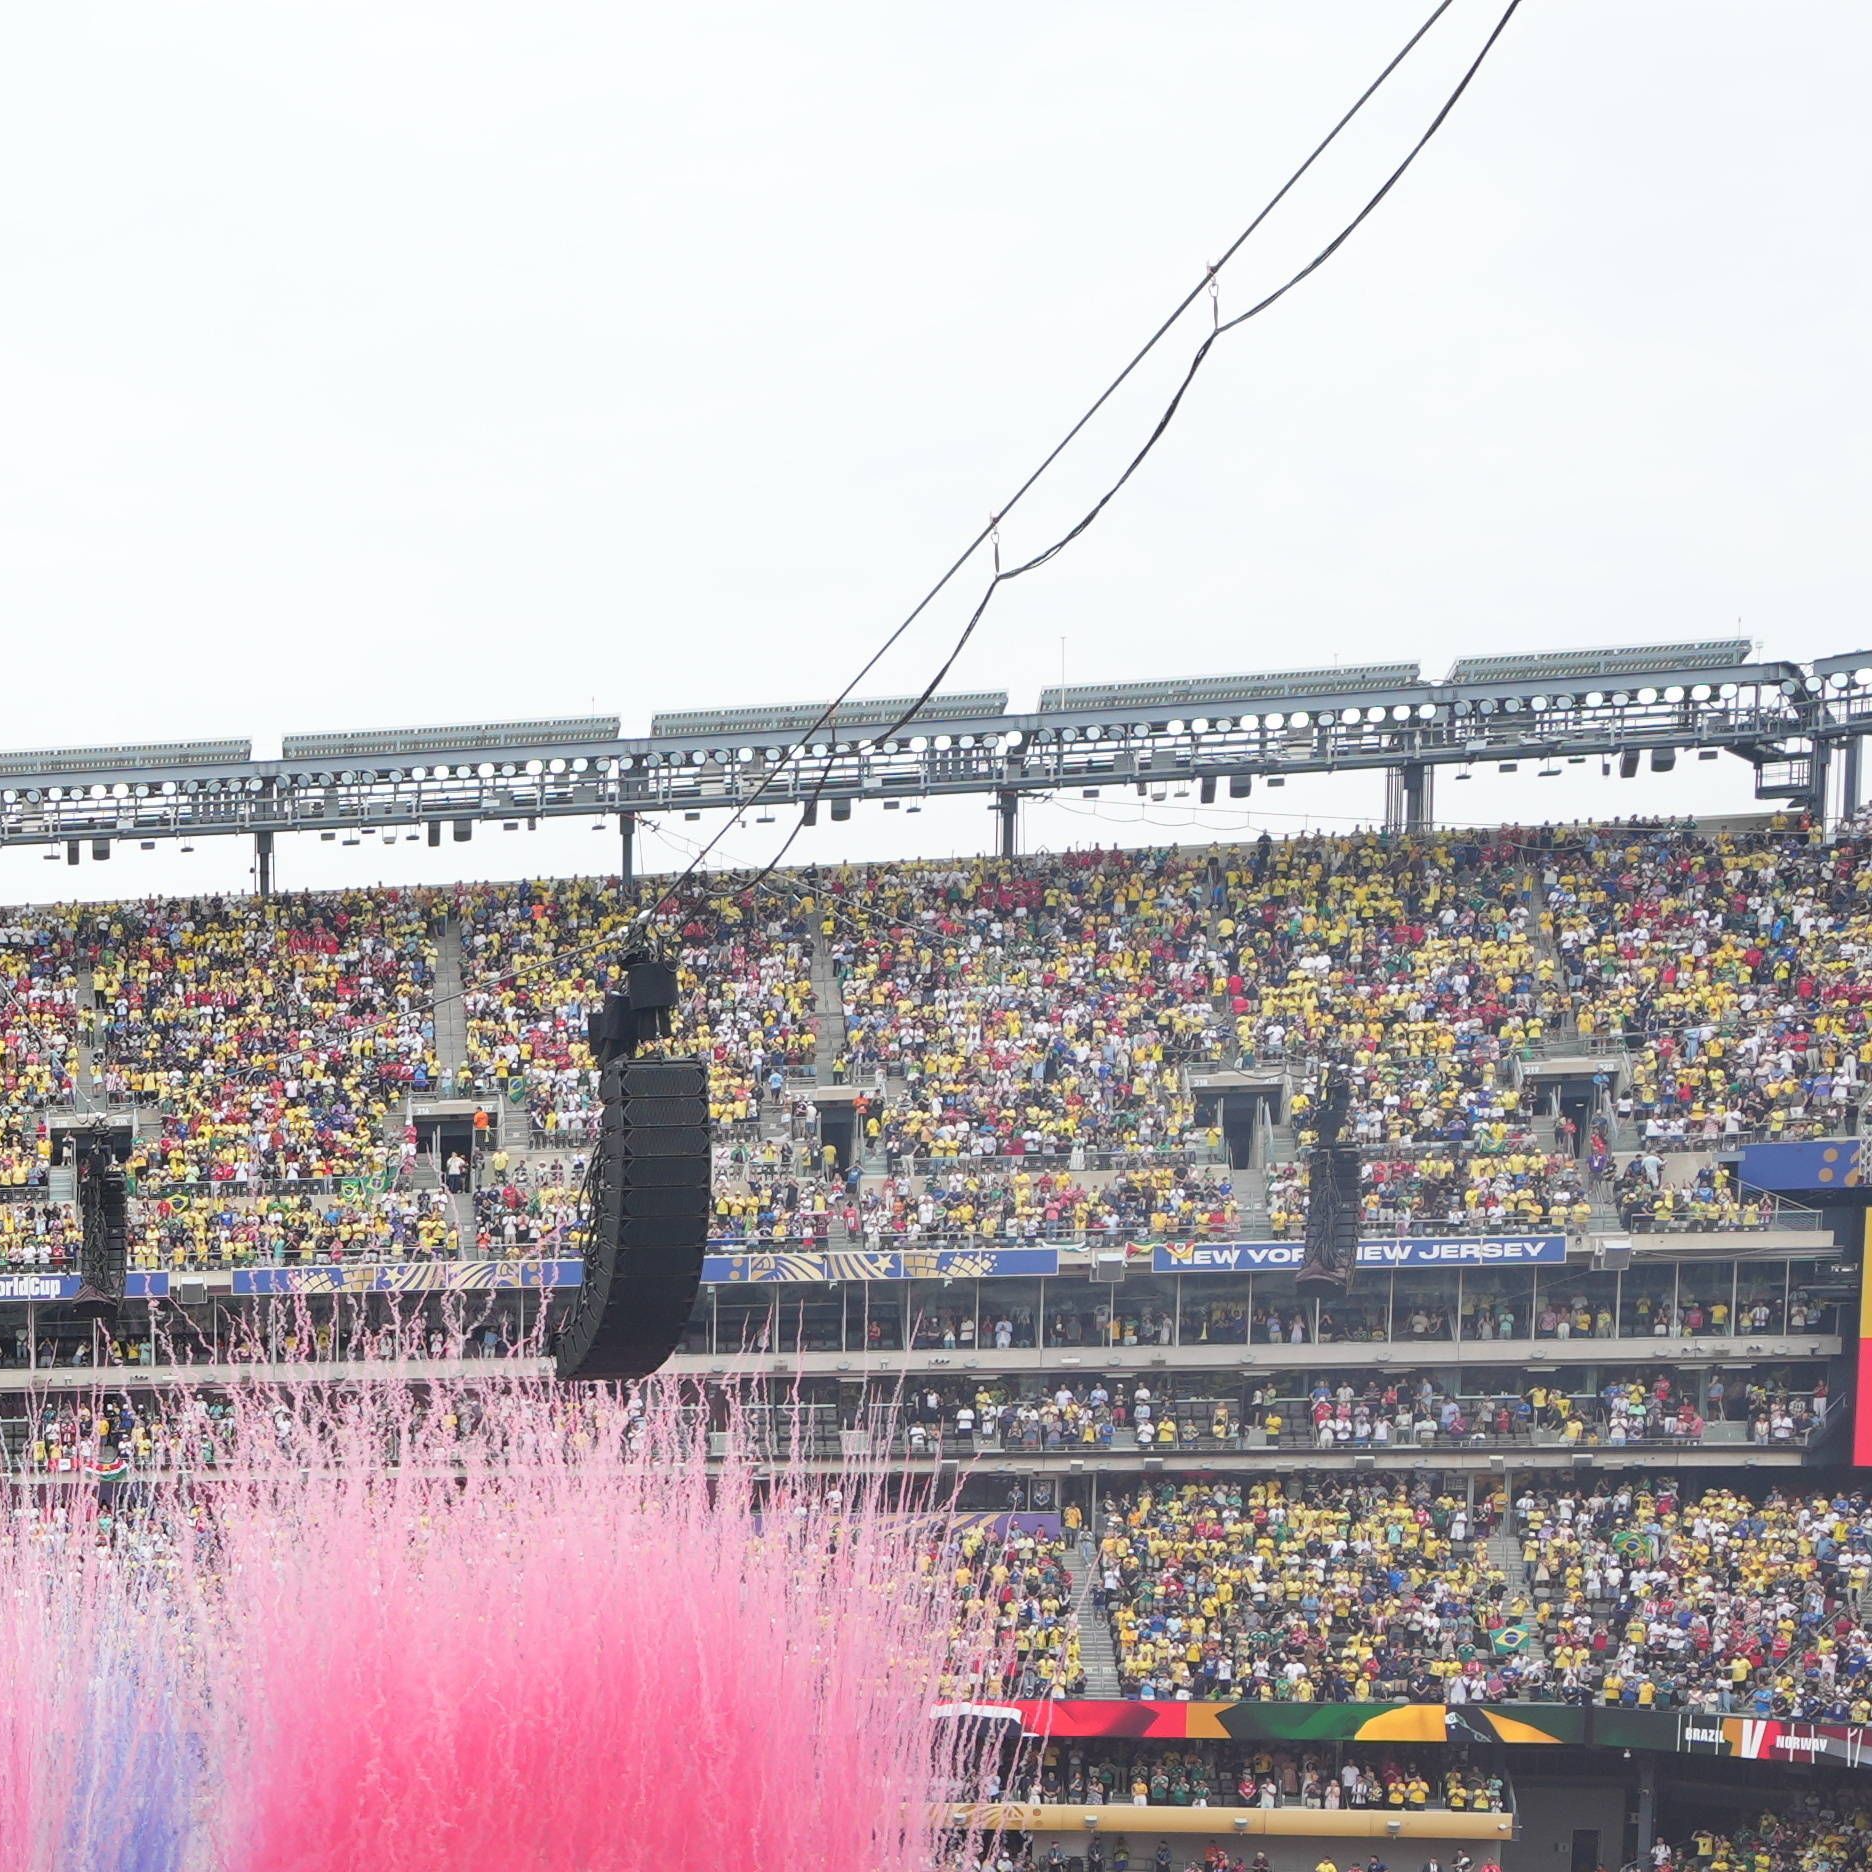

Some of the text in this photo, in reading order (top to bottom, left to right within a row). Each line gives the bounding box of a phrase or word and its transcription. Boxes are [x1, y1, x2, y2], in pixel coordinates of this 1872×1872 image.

[1418, 1240, 1546, 1260] JERSEY
[1685, 1718, 1828, 1759] BRAZIL V NORWAY
